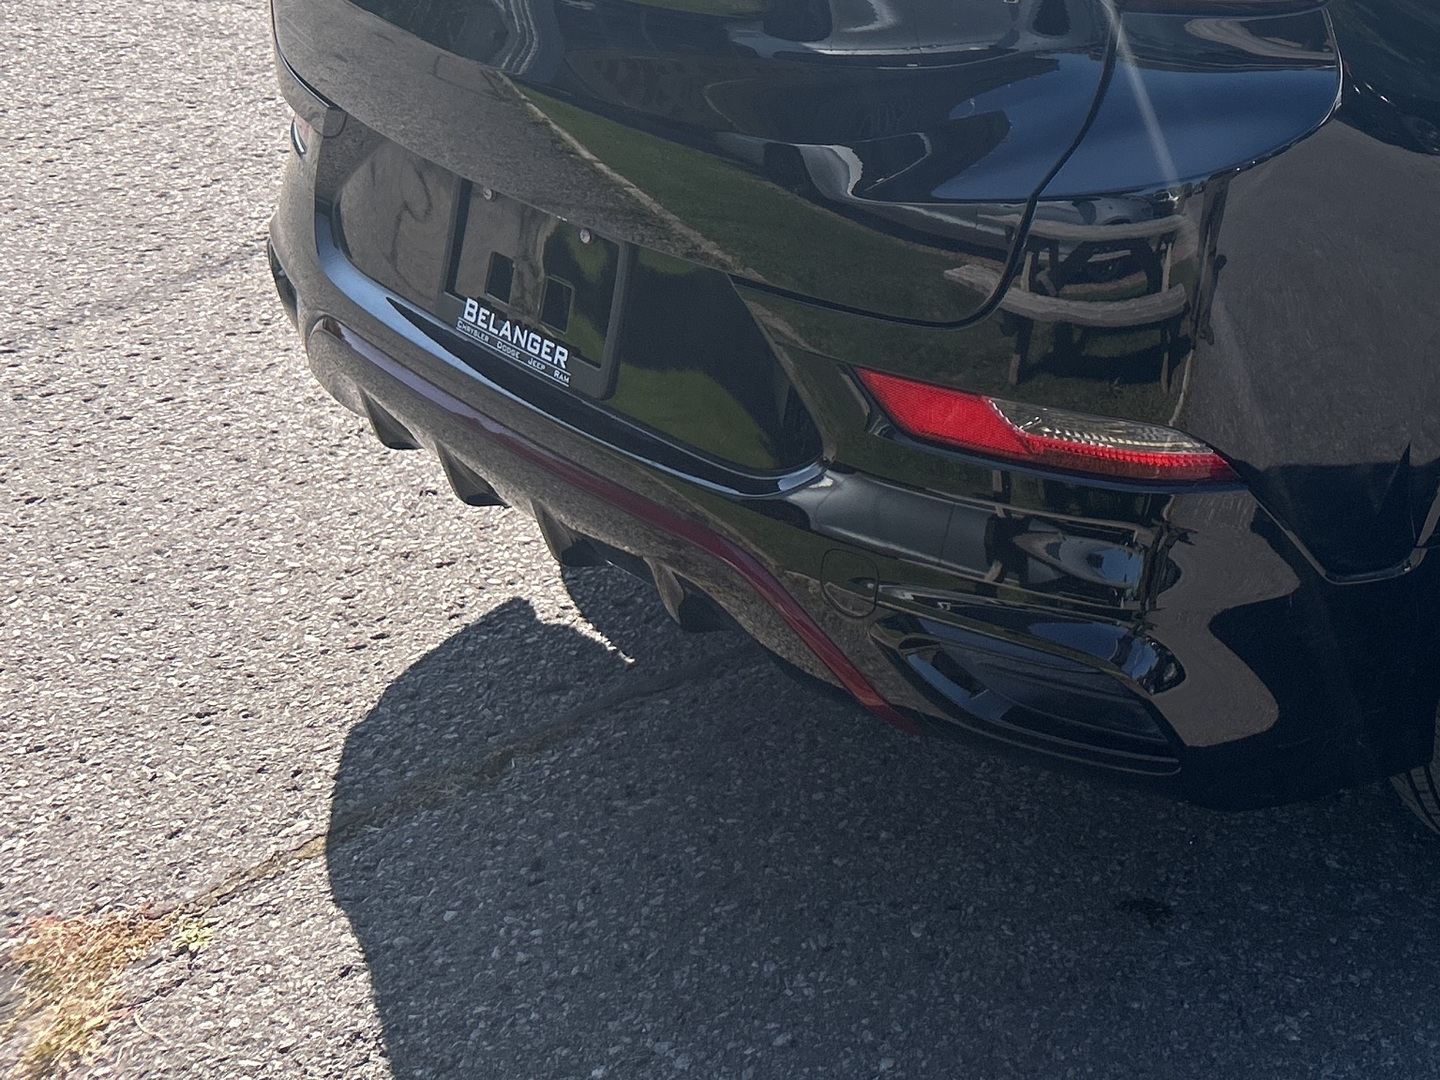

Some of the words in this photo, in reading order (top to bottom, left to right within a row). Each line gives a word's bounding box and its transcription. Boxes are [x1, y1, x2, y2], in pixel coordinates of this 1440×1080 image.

[457, 320, 490, 343] CHRYSLER
[496, 340, 521, 359] DODGE
[527, 357, 546, 371] JEEP
[553, 369, 570, 384] RAM
[463, 297, 569, 369] BELANGER
